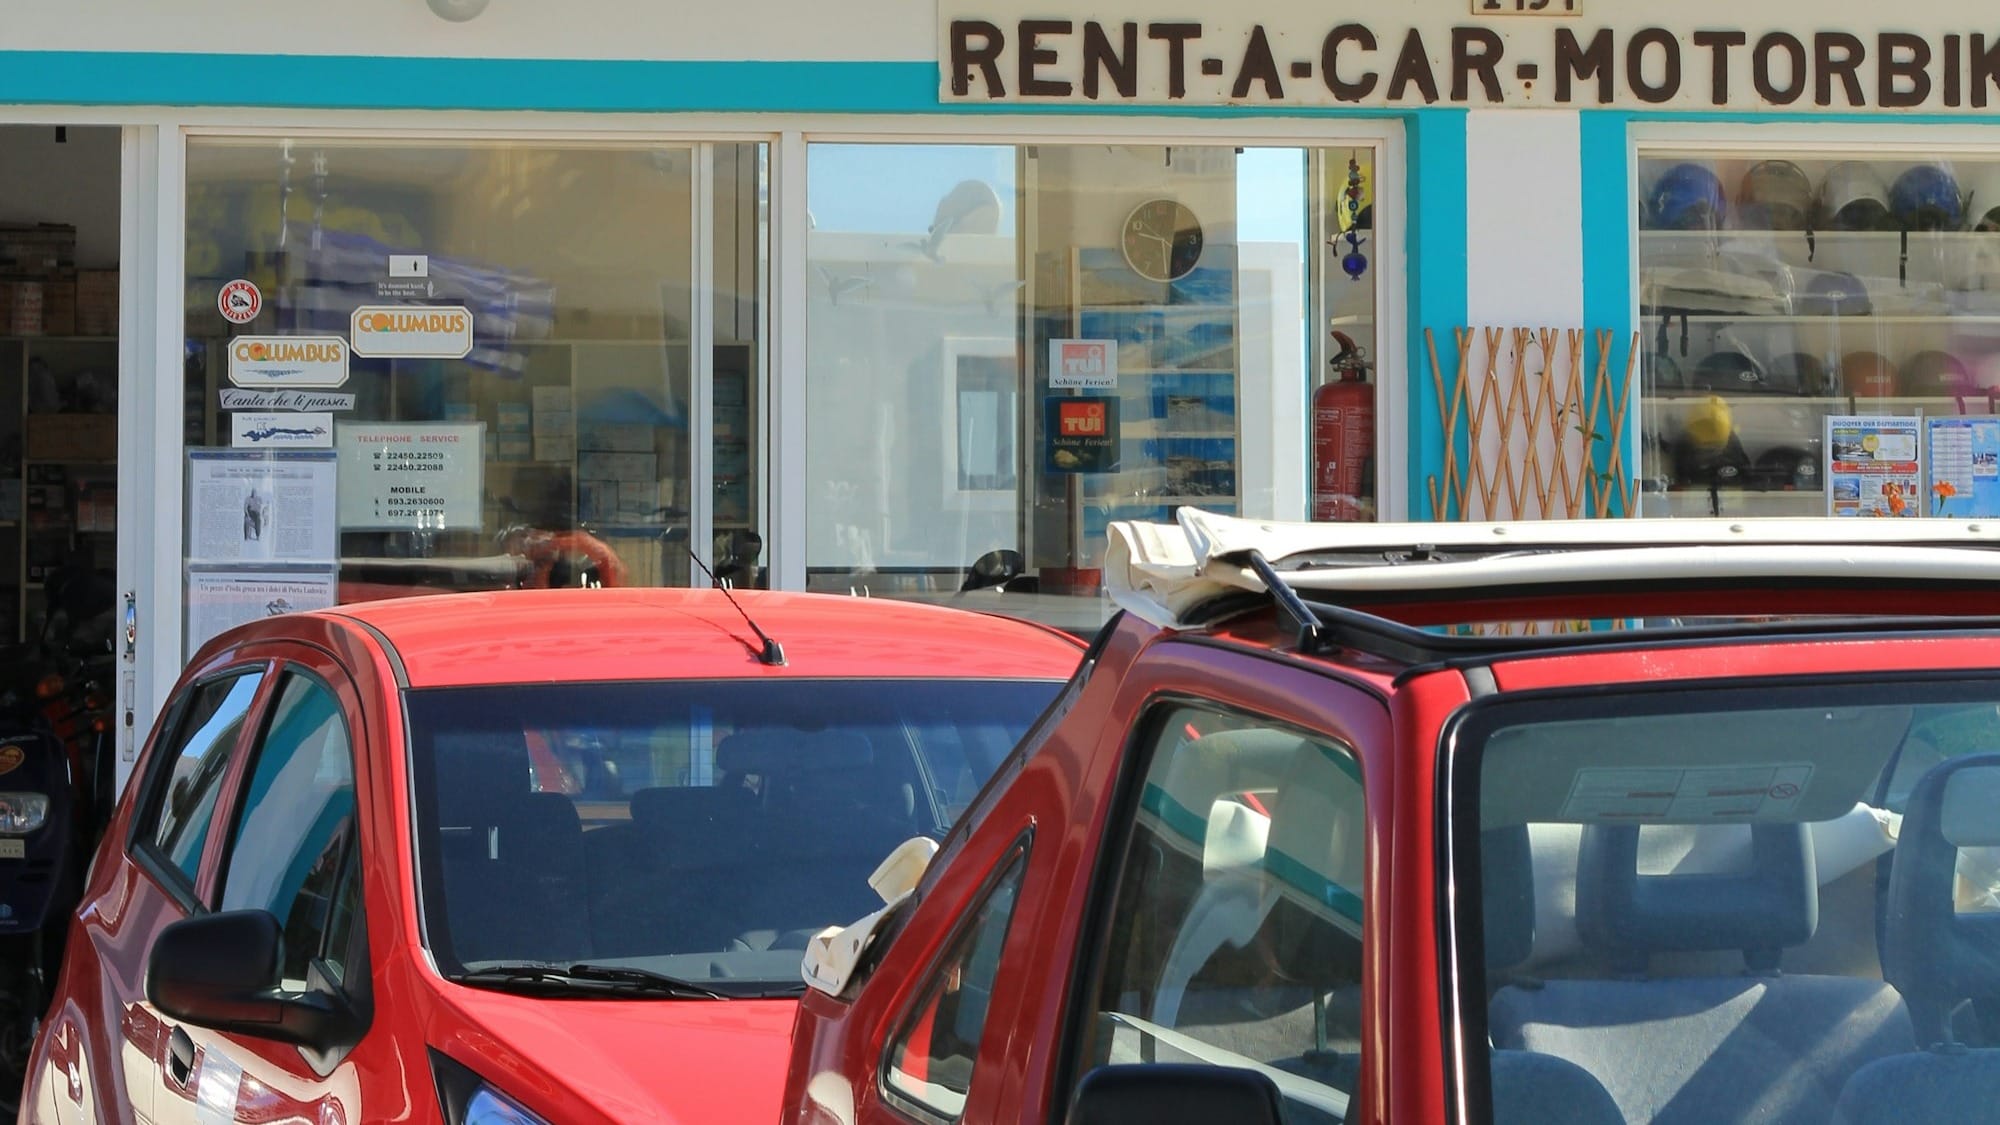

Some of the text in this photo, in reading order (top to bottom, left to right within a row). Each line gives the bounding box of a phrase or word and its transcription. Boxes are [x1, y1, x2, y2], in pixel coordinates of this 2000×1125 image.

[1189, 234, 1197, 245] 3
[358, 313, 465, 333] COLUMBUS
[235, 342, 341, 362] COLUMBUS
[1065, 350, 1102, 373] TUI
[223, 393, 265, 406] Canta
[267, 394, 288, 406] che
[1064, 409, 1101, 431] TUI
[357, 435, 460, 443] TELEPHONE SERVICE
[390, 486, 426, 494] MOBILE
